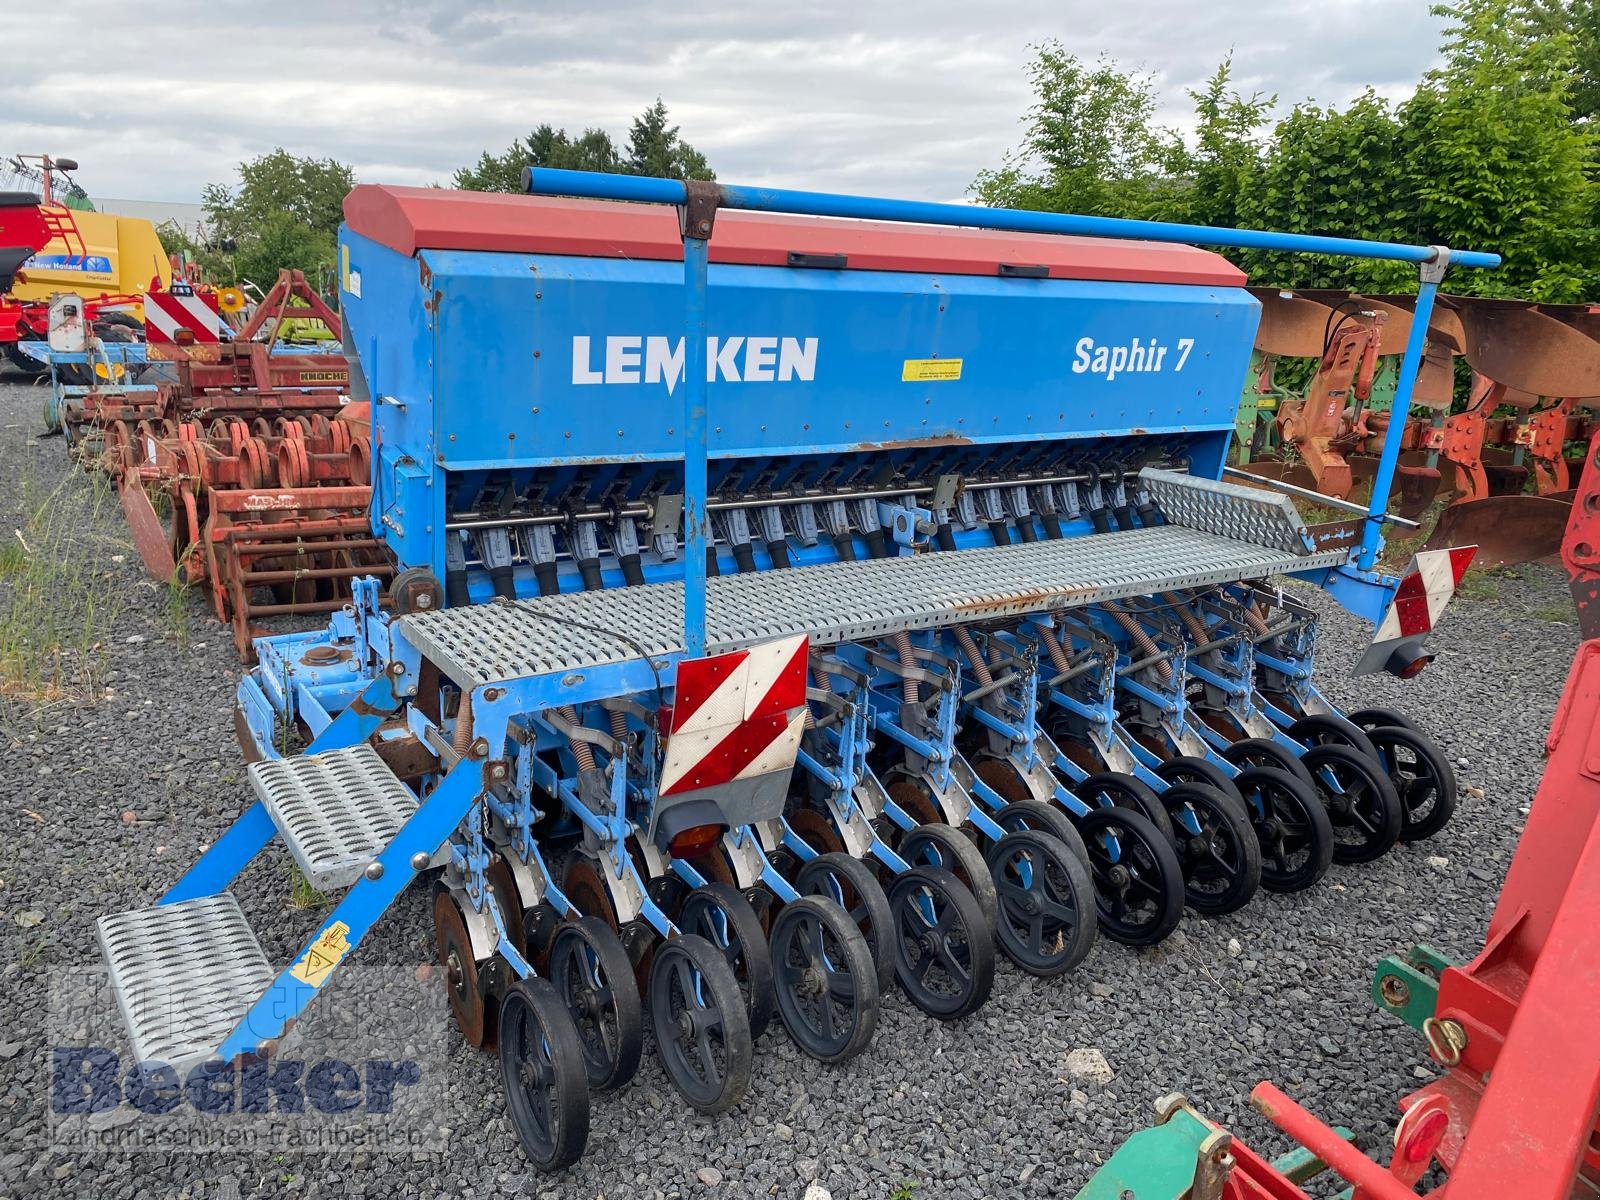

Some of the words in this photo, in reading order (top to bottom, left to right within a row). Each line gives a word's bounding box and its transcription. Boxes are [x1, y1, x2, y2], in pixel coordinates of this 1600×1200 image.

[35, 262, 52, 270] New
[53, 262, 83, 271] Holland
[572, 336, 819, 397] LEMKEN
[1072, 337, 1168, 381] Saphir
[1174, 338, 1195, 372] 7
[300, 372, 348, 382] KNOCHE
